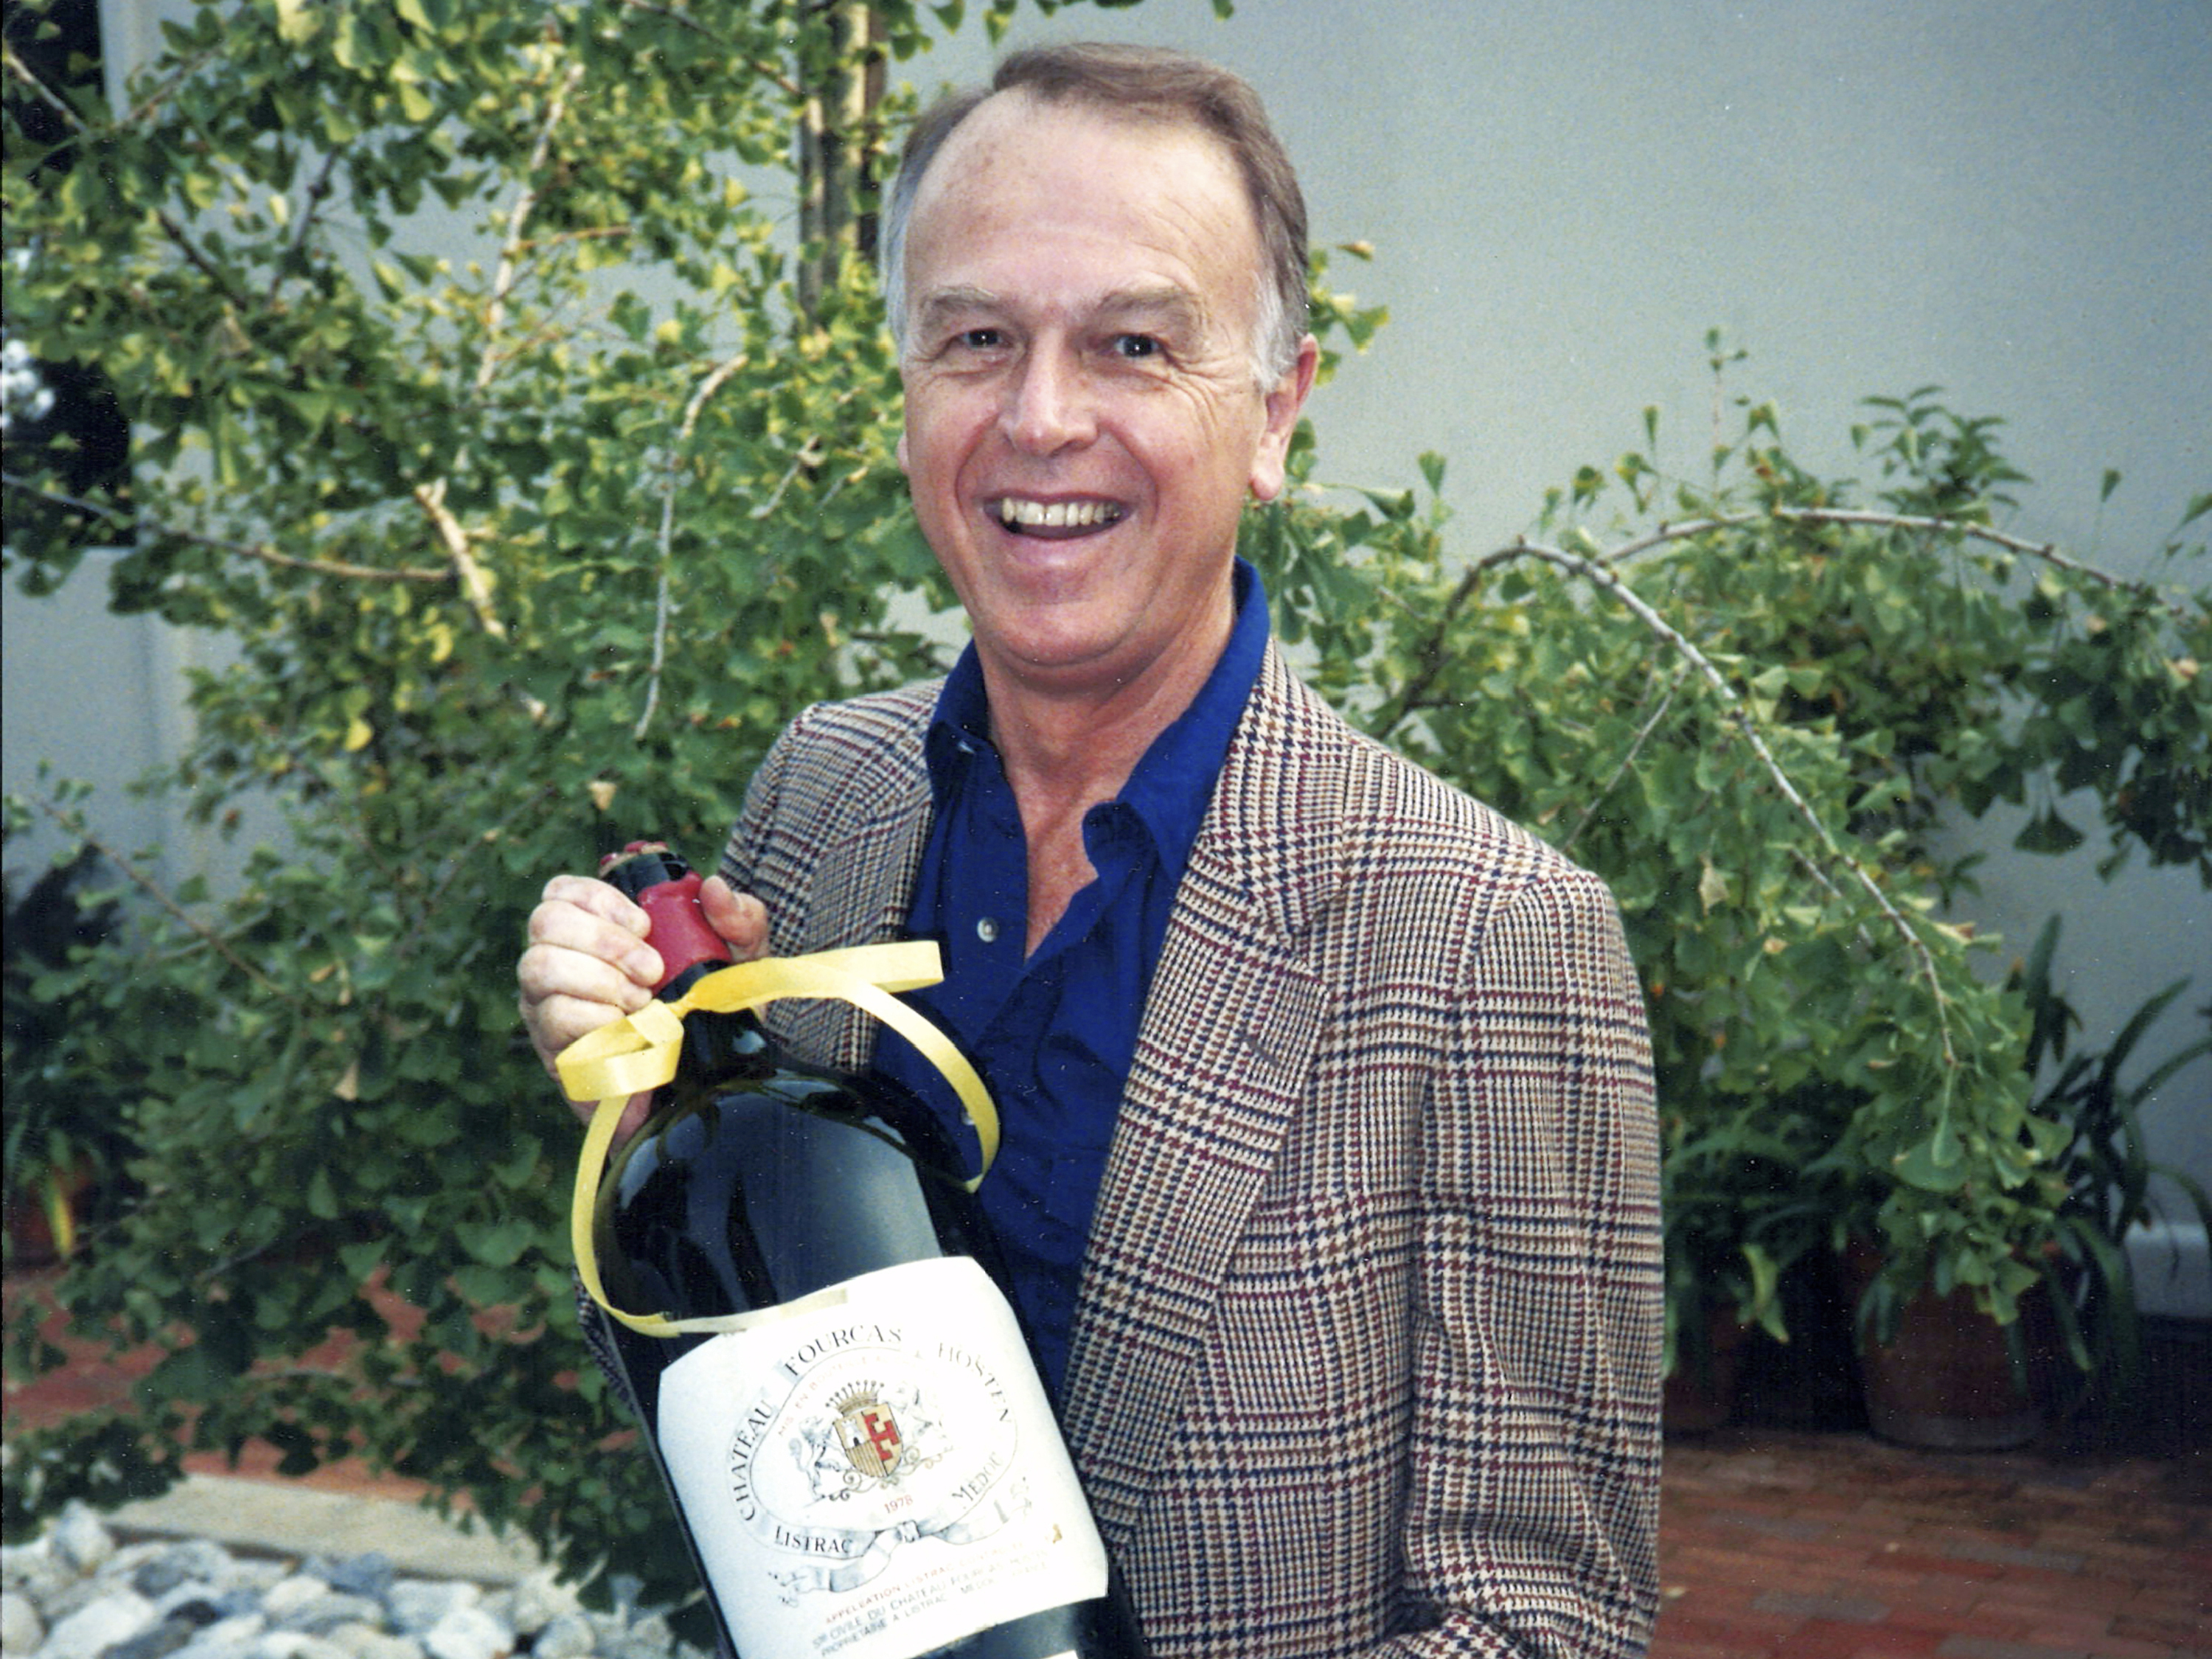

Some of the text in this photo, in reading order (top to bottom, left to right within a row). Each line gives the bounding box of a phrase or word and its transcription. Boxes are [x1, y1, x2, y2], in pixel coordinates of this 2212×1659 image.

[731, 1325, 1012, 1521] CHATEAU FOURCAS HOSTEN
[884, 1495, 914, 1514] 1978
[775, 1526, 854, 1554] LISTRAC
[905, 1563, 954, 1587] LISTRAC
[867, 1605, 886, 1621] DU
